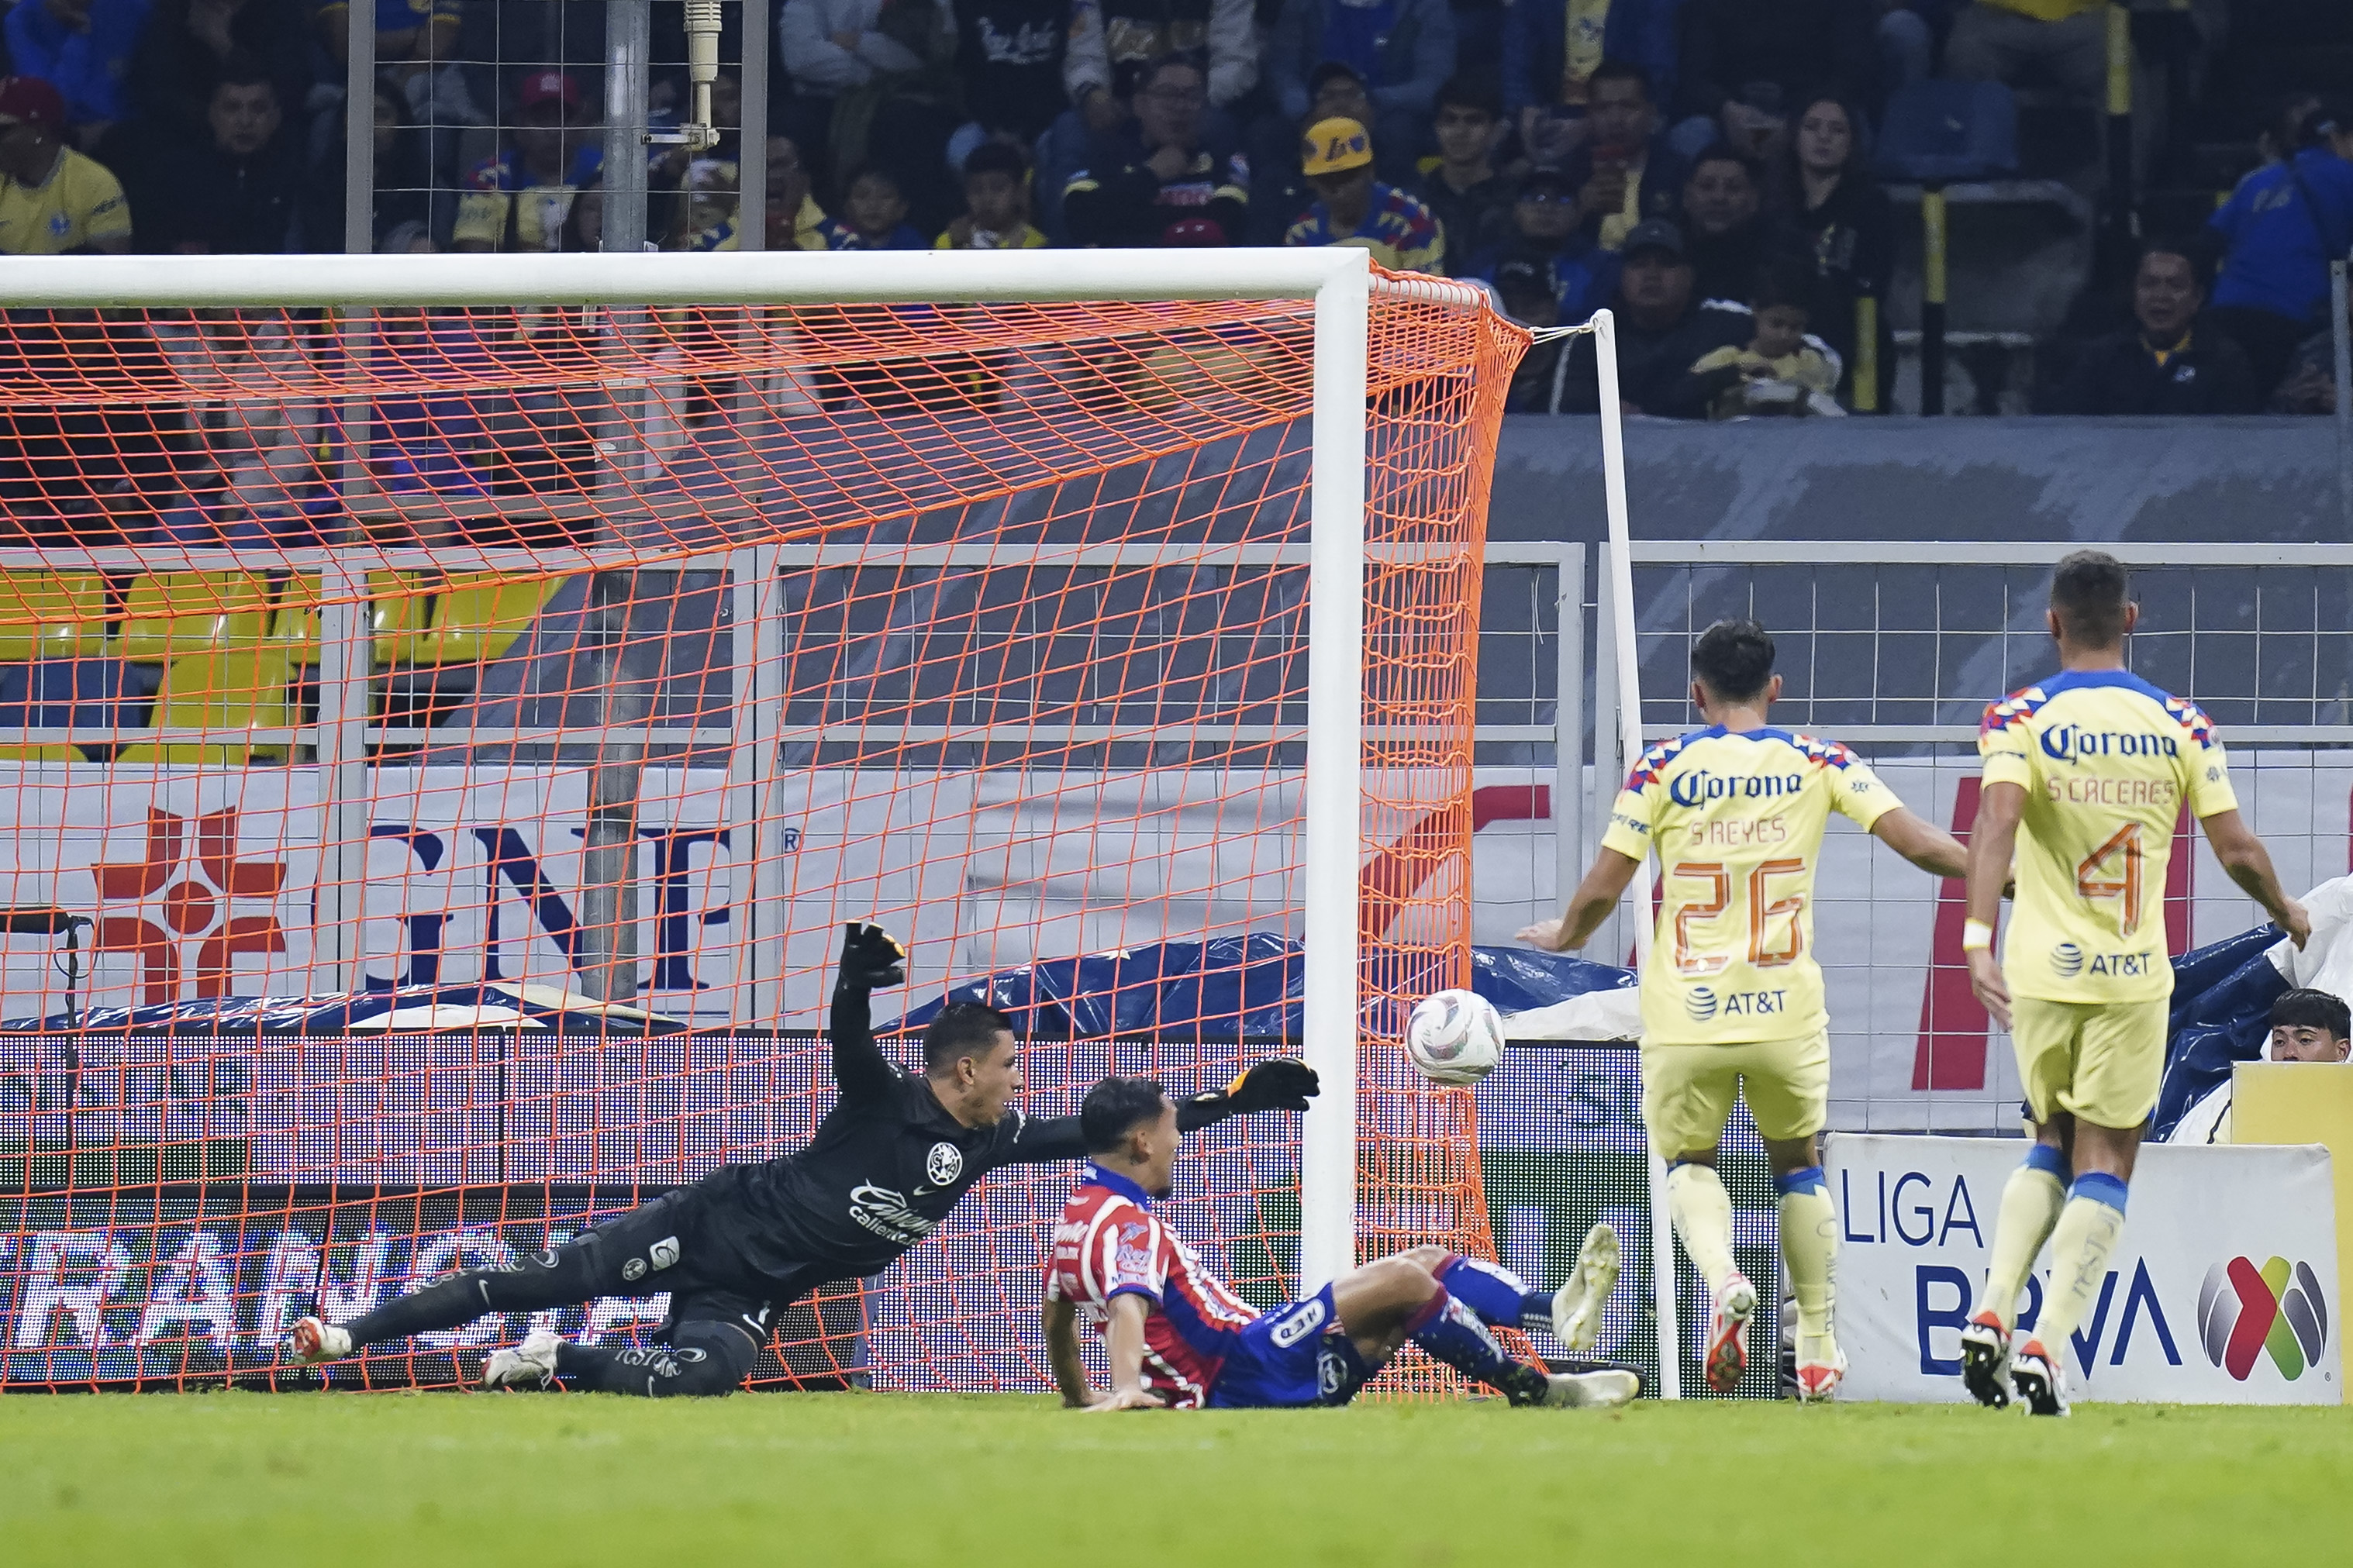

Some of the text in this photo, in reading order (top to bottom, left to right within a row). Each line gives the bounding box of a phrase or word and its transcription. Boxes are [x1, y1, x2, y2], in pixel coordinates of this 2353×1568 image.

[2041, 723, 2179, 765] Corona
[1671, 769, 1803, 810] Corona
[2048, 777, 2061, 801] S
[1692, 816, 1786, 846] S REYES
[2078, 822, 2142, 938] 4
[1674, 856, 1806, 974] 26
[2089, 953, 2152, 977] AT&T
[1724, 990, 1786, 1015] AT&T
[1842, 1168, 1984, 1248] LIGA
